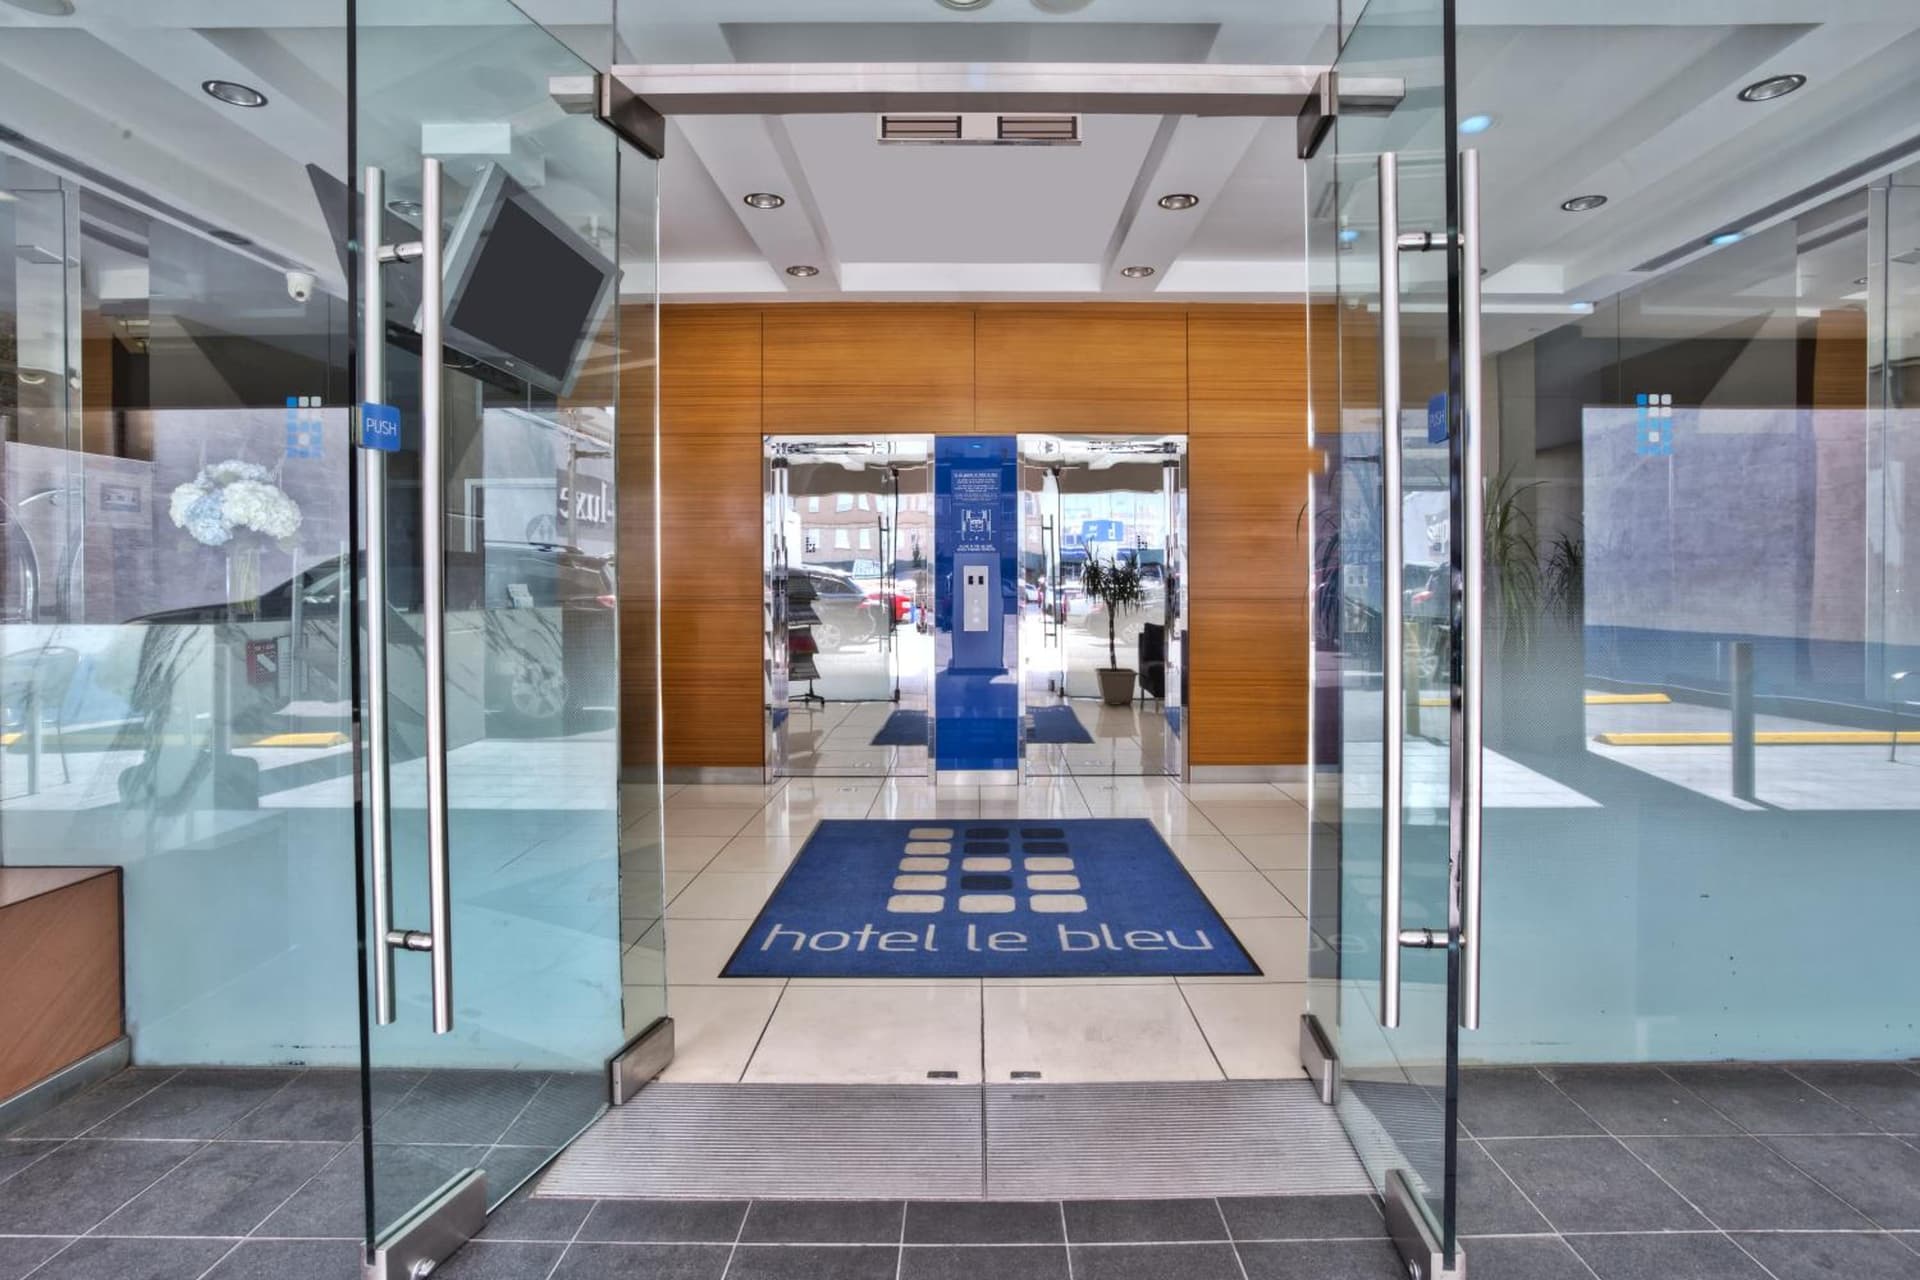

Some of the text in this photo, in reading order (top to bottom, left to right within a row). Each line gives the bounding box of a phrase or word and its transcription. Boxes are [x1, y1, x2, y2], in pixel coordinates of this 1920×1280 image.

[366, 417, 397, 437] PUSH
[760, 923, 1214, 952] hotel le bleu
